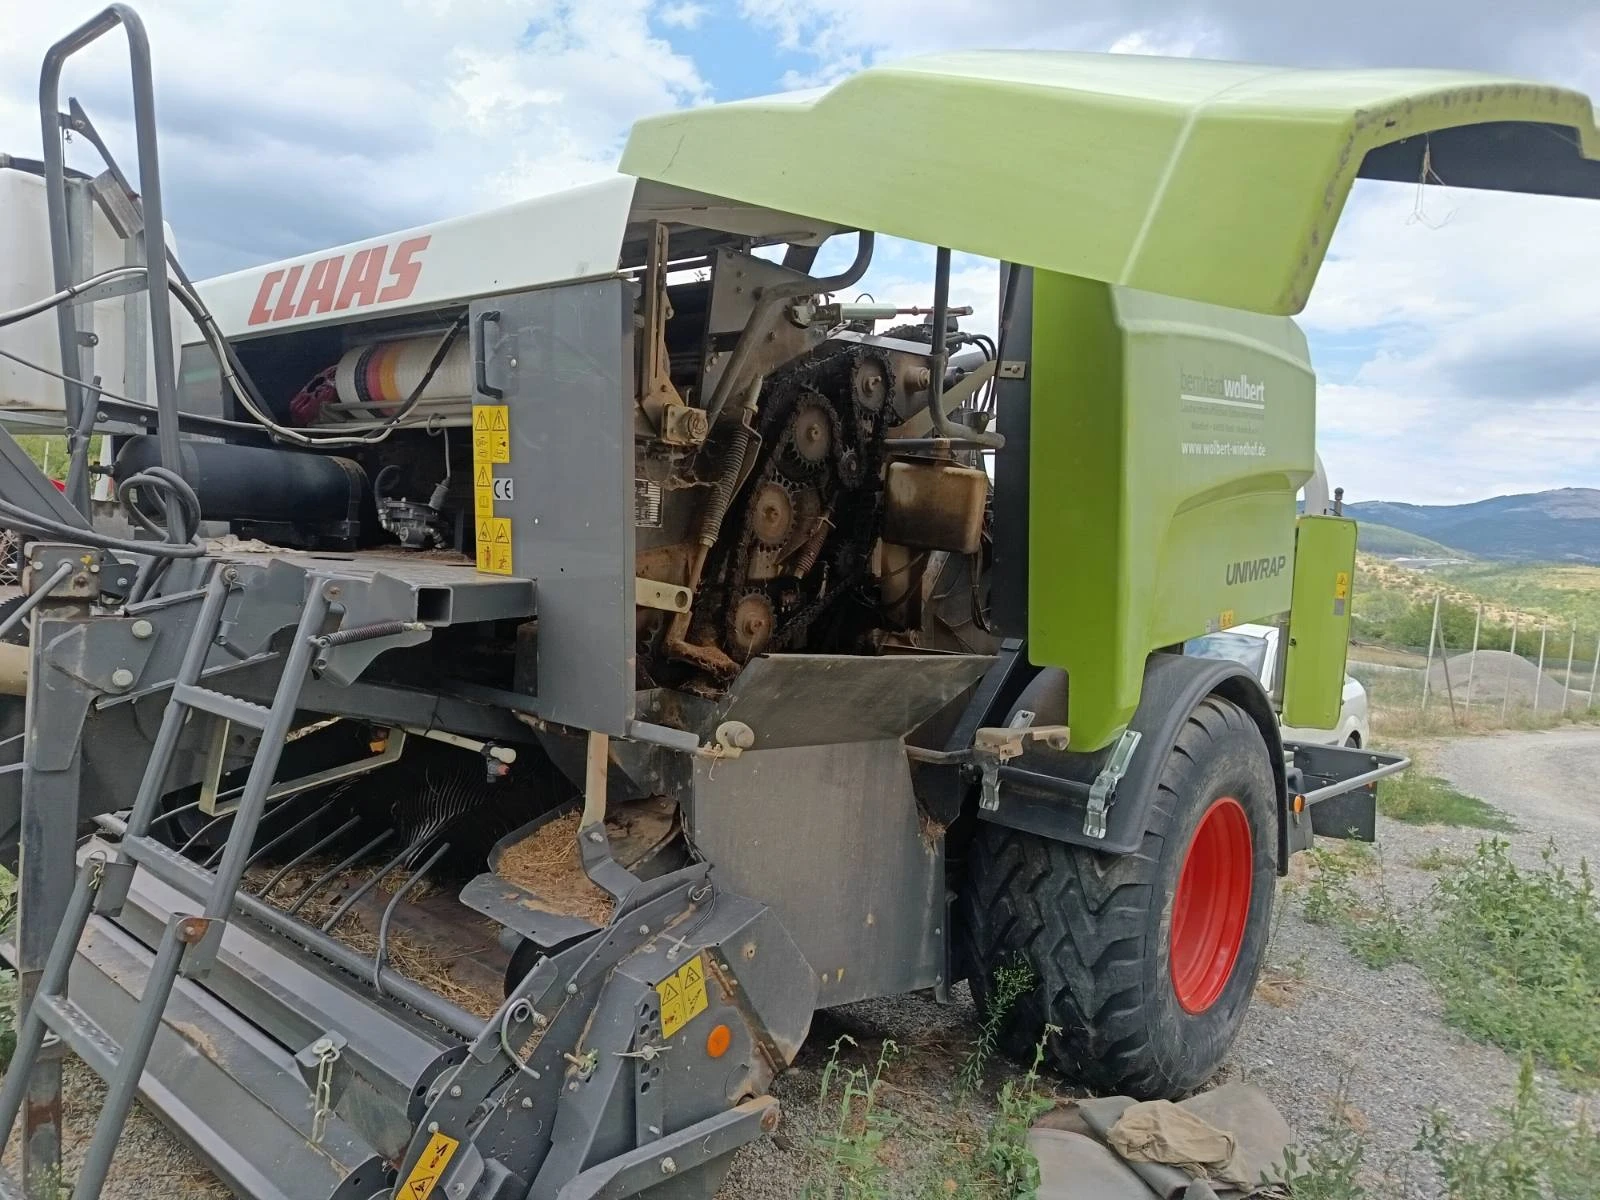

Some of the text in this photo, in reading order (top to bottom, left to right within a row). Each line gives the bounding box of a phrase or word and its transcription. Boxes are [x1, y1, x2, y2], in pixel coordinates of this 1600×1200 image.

[248, 235, 432, 326] CLAAS
[494, 480, 511, 499] CE
[1225, 556, 1286, 586] UNIWRAP
